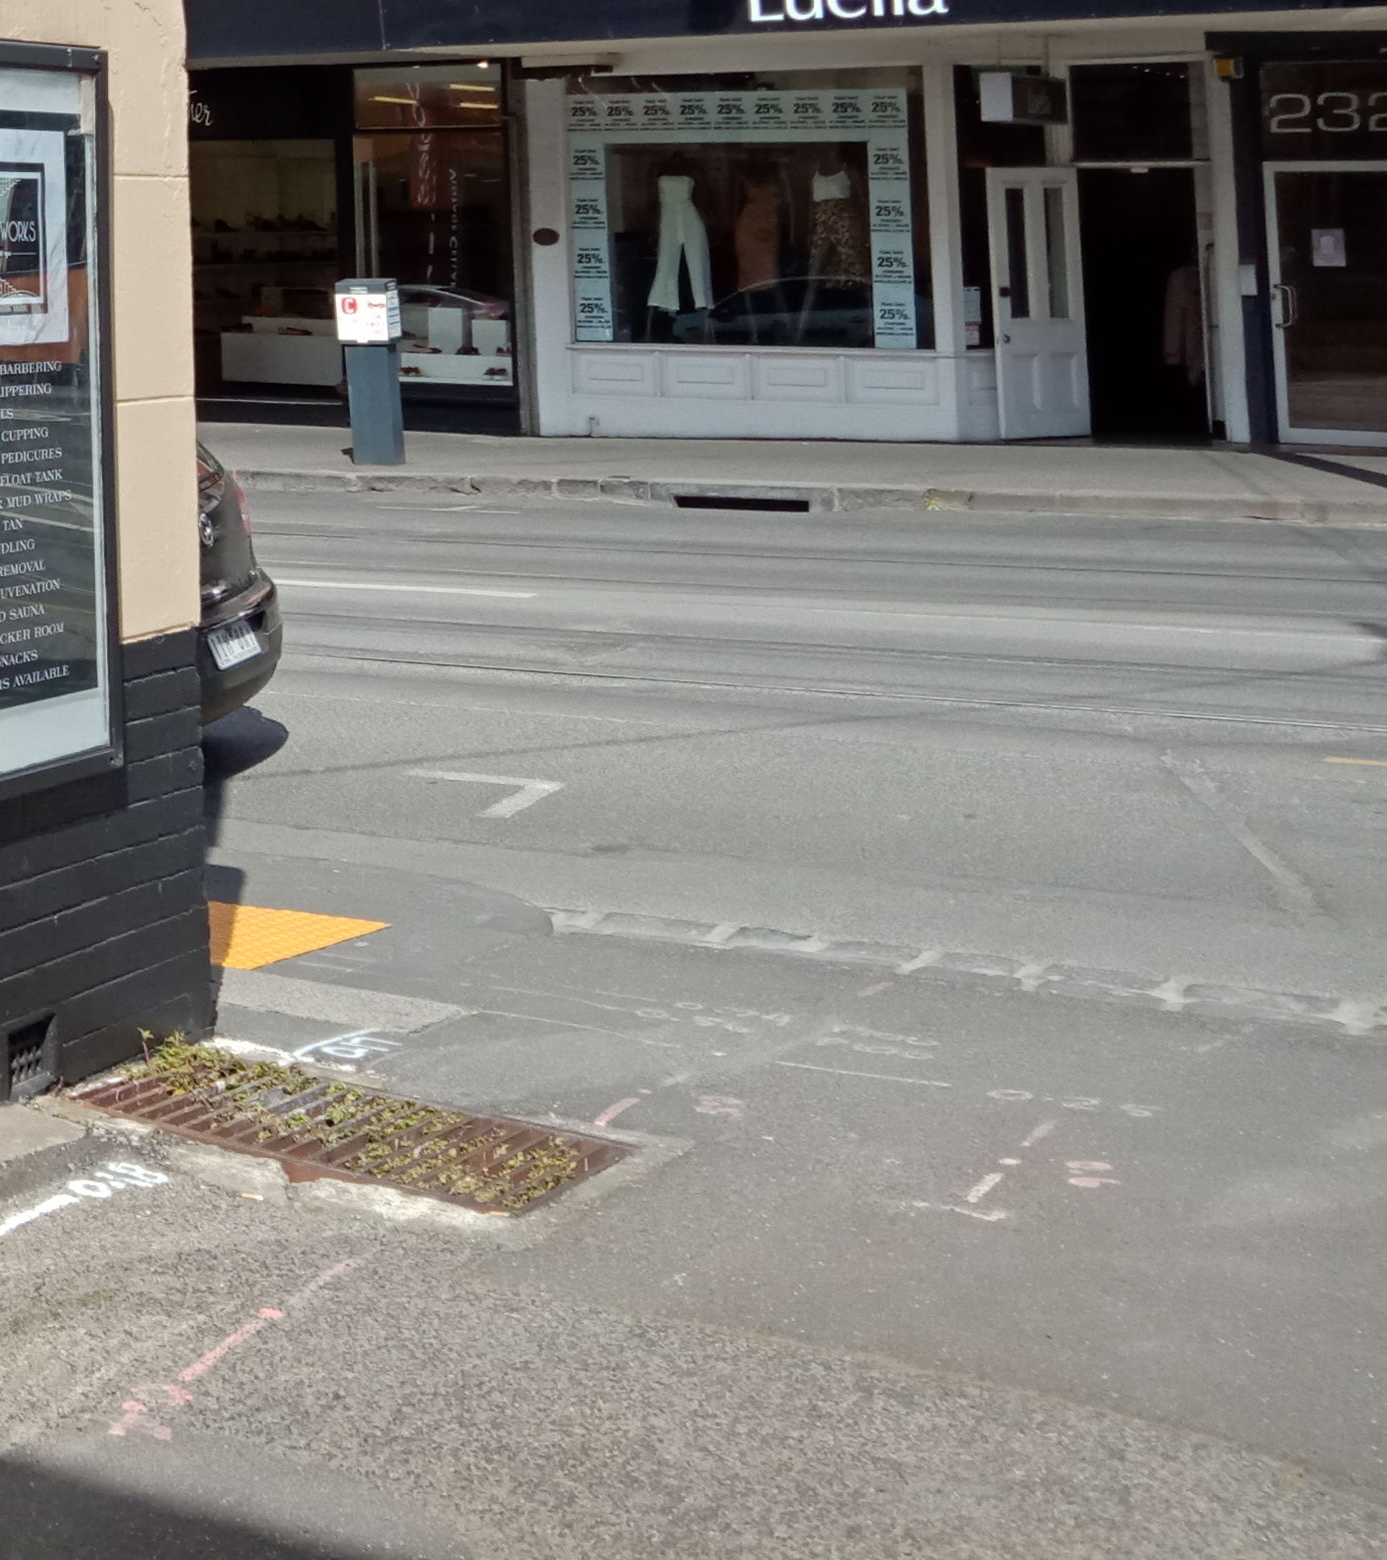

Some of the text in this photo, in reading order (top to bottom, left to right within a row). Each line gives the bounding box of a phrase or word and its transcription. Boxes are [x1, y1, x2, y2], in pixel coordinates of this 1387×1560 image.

[572, 155, 599, 166] 25%
[873, 154, 901, 165] 25%
[575, 204, 601, 215] 25%
[875, 205, 904, 217] 25%
[0, 221, 36, 242] WORKS
[577, 253, 603, 264] 25%
[877, 256, 906, 268] 25%
[579, 303, 606, 314] 25%
[879, 308, 908, 320] 25%
[0, 361, 62, 375] BARBERING
[1, 427, 49, 442] CUPPING
[1, 447, 62, 464] PEDICURES
[0, 473, 31, 487] FLOAT
[35, 469, 63, 482] TANK
[7, 493, 31, 508] MUD
[34, 489, 72, 505] WRAPS
[2, 518, 23, 532] TAN
[9, 603, 45, 620] SAUNA
[34, 621, 64, 638] ROOM
[13, 665, 70, 687] AVAILABLE
